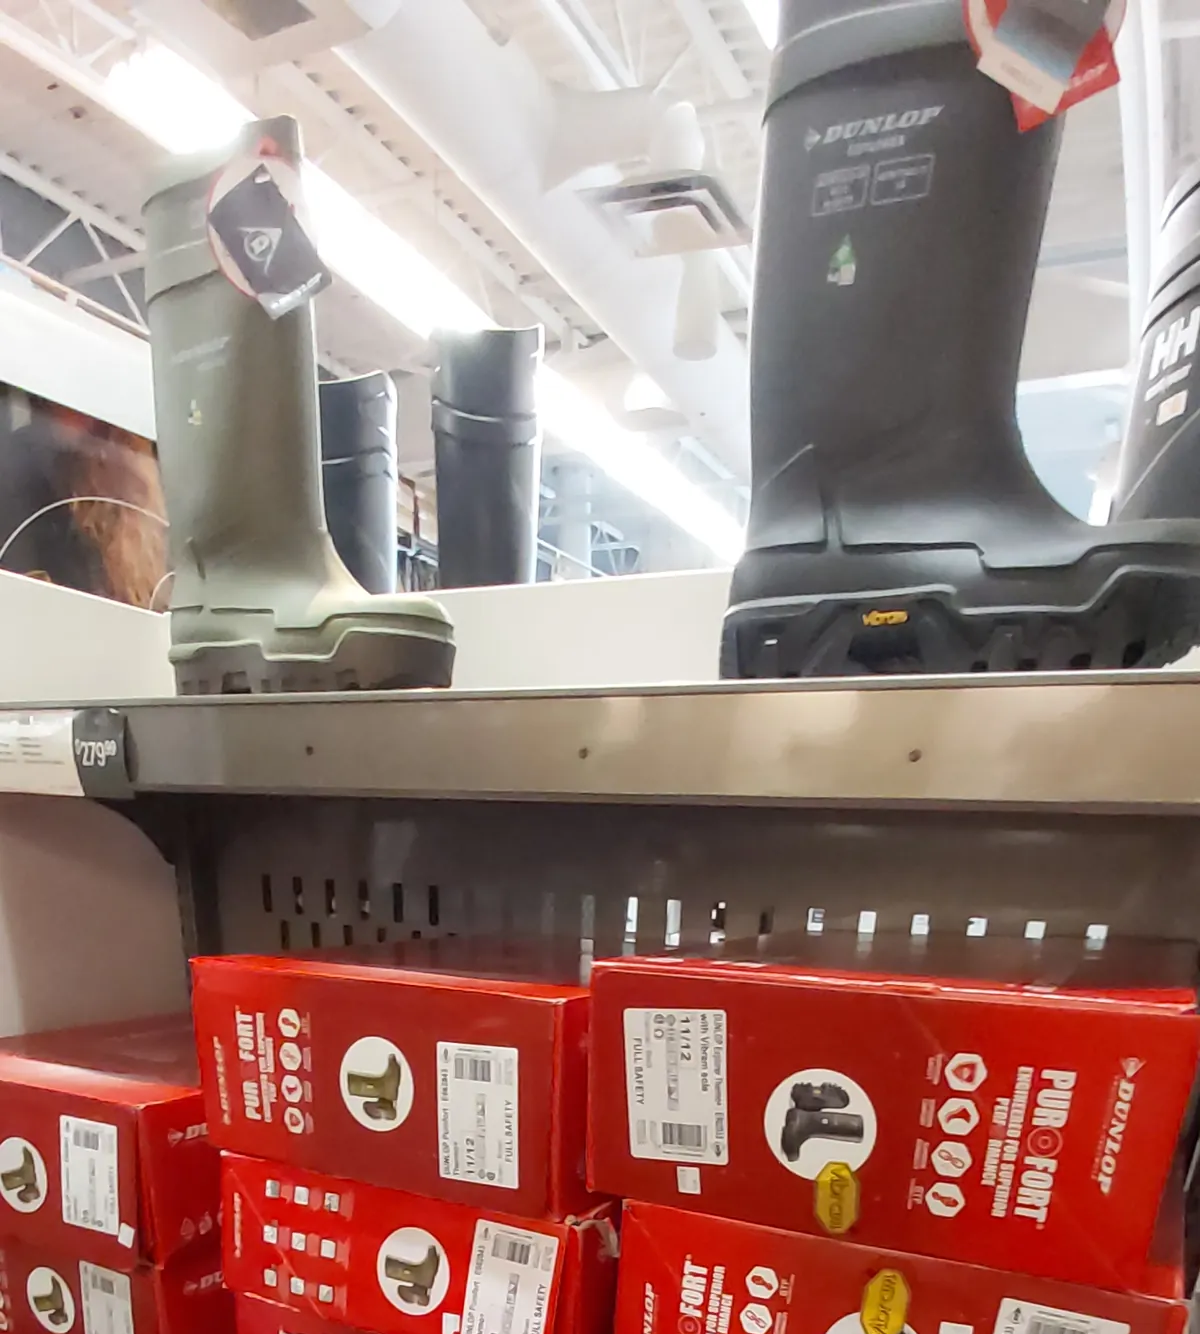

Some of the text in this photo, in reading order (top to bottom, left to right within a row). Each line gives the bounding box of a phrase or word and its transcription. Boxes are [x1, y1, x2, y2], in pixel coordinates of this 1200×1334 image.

[822, 104, 946, 144] DUNLOP
[1148, 305, 1200, 380] HH
[680, 1016, 692, 1061] 11/12
[700, 1014, 708, 1033] with
[235, 1009, 262, 1120] PURFORT
[633, 1038, 644, 1105] FULL SAFETY
[700, 1034, 709, 1069] Vibram
[505, 1100, 514, 1163] FULL SAFETY
[1098, 1079, 1135, 1195] DUNLOP
[533, 1283, 547, 1318] SAFETY
[708, 1265, 726, 1314] SUPERIOR
